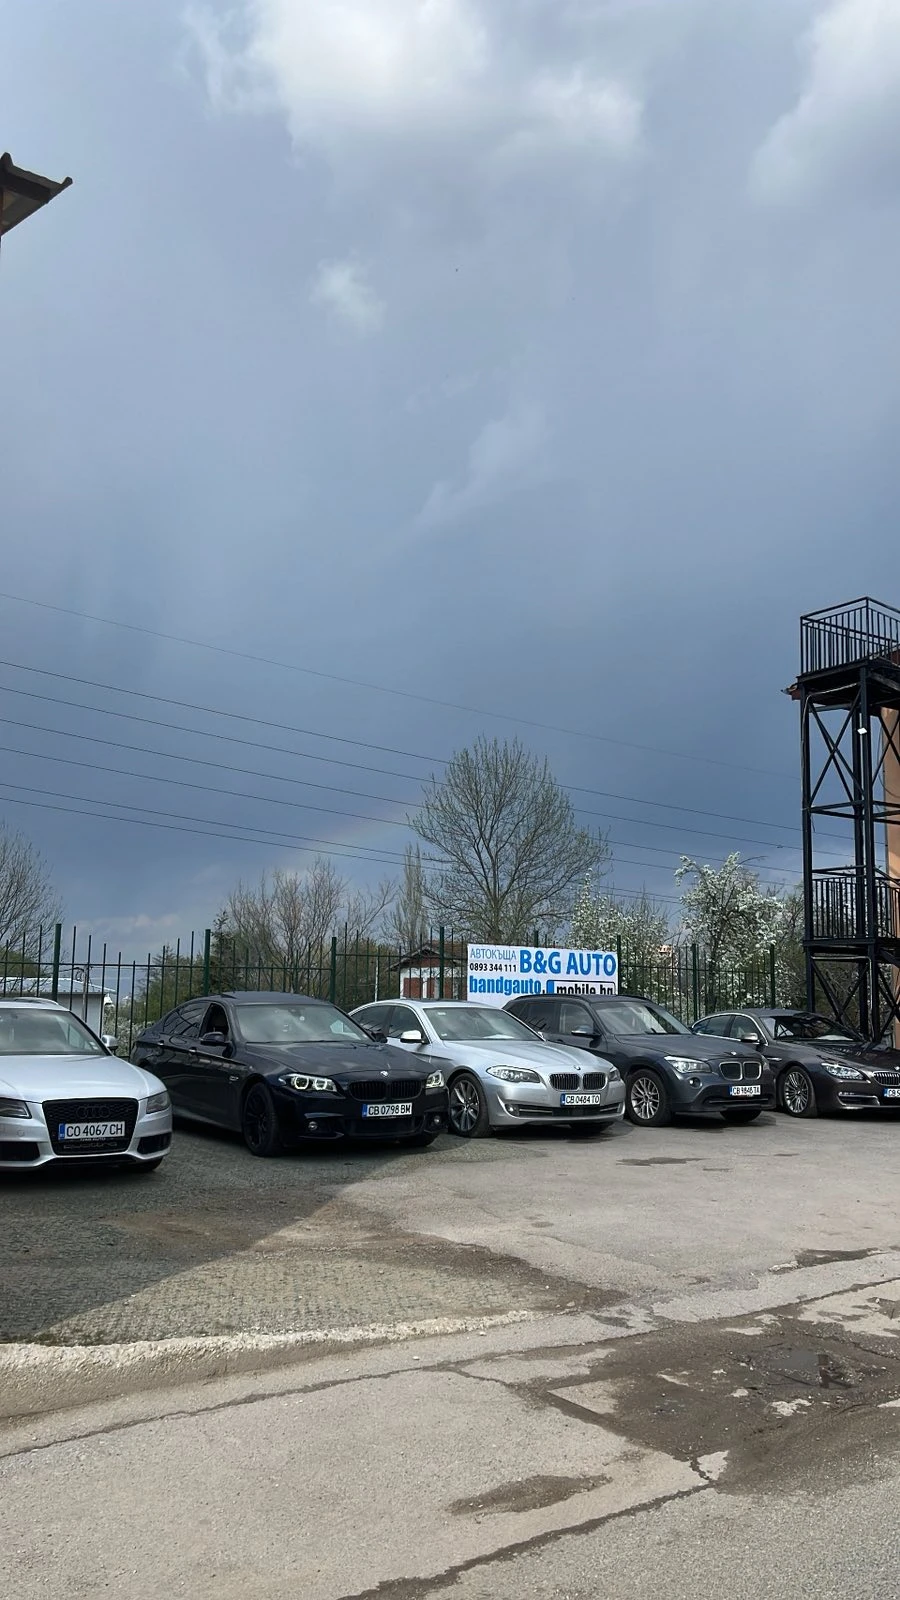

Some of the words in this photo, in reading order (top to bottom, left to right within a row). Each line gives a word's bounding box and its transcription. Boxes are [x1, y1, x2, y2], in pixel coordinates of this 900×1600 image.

[470, 948, 517, 961] АВТОКЪЩА
[469, 962, 488, 972] 0893
[489, 963, 503, 973] 344
[504, 964, 517, 973] 111
[519, 950, 561, 974] B&G
[566, 953, 617, 976] AUTO
[566, 1095, 575, 1104] CB
[368, 1105, 380, 1116] CB
[380, 1105, 400, 1115] 0798
[66, 1125, 81, 1137] CO
[82, 1124, 108, 1137] 4067
[109, 1123, 123, 1135] CH
